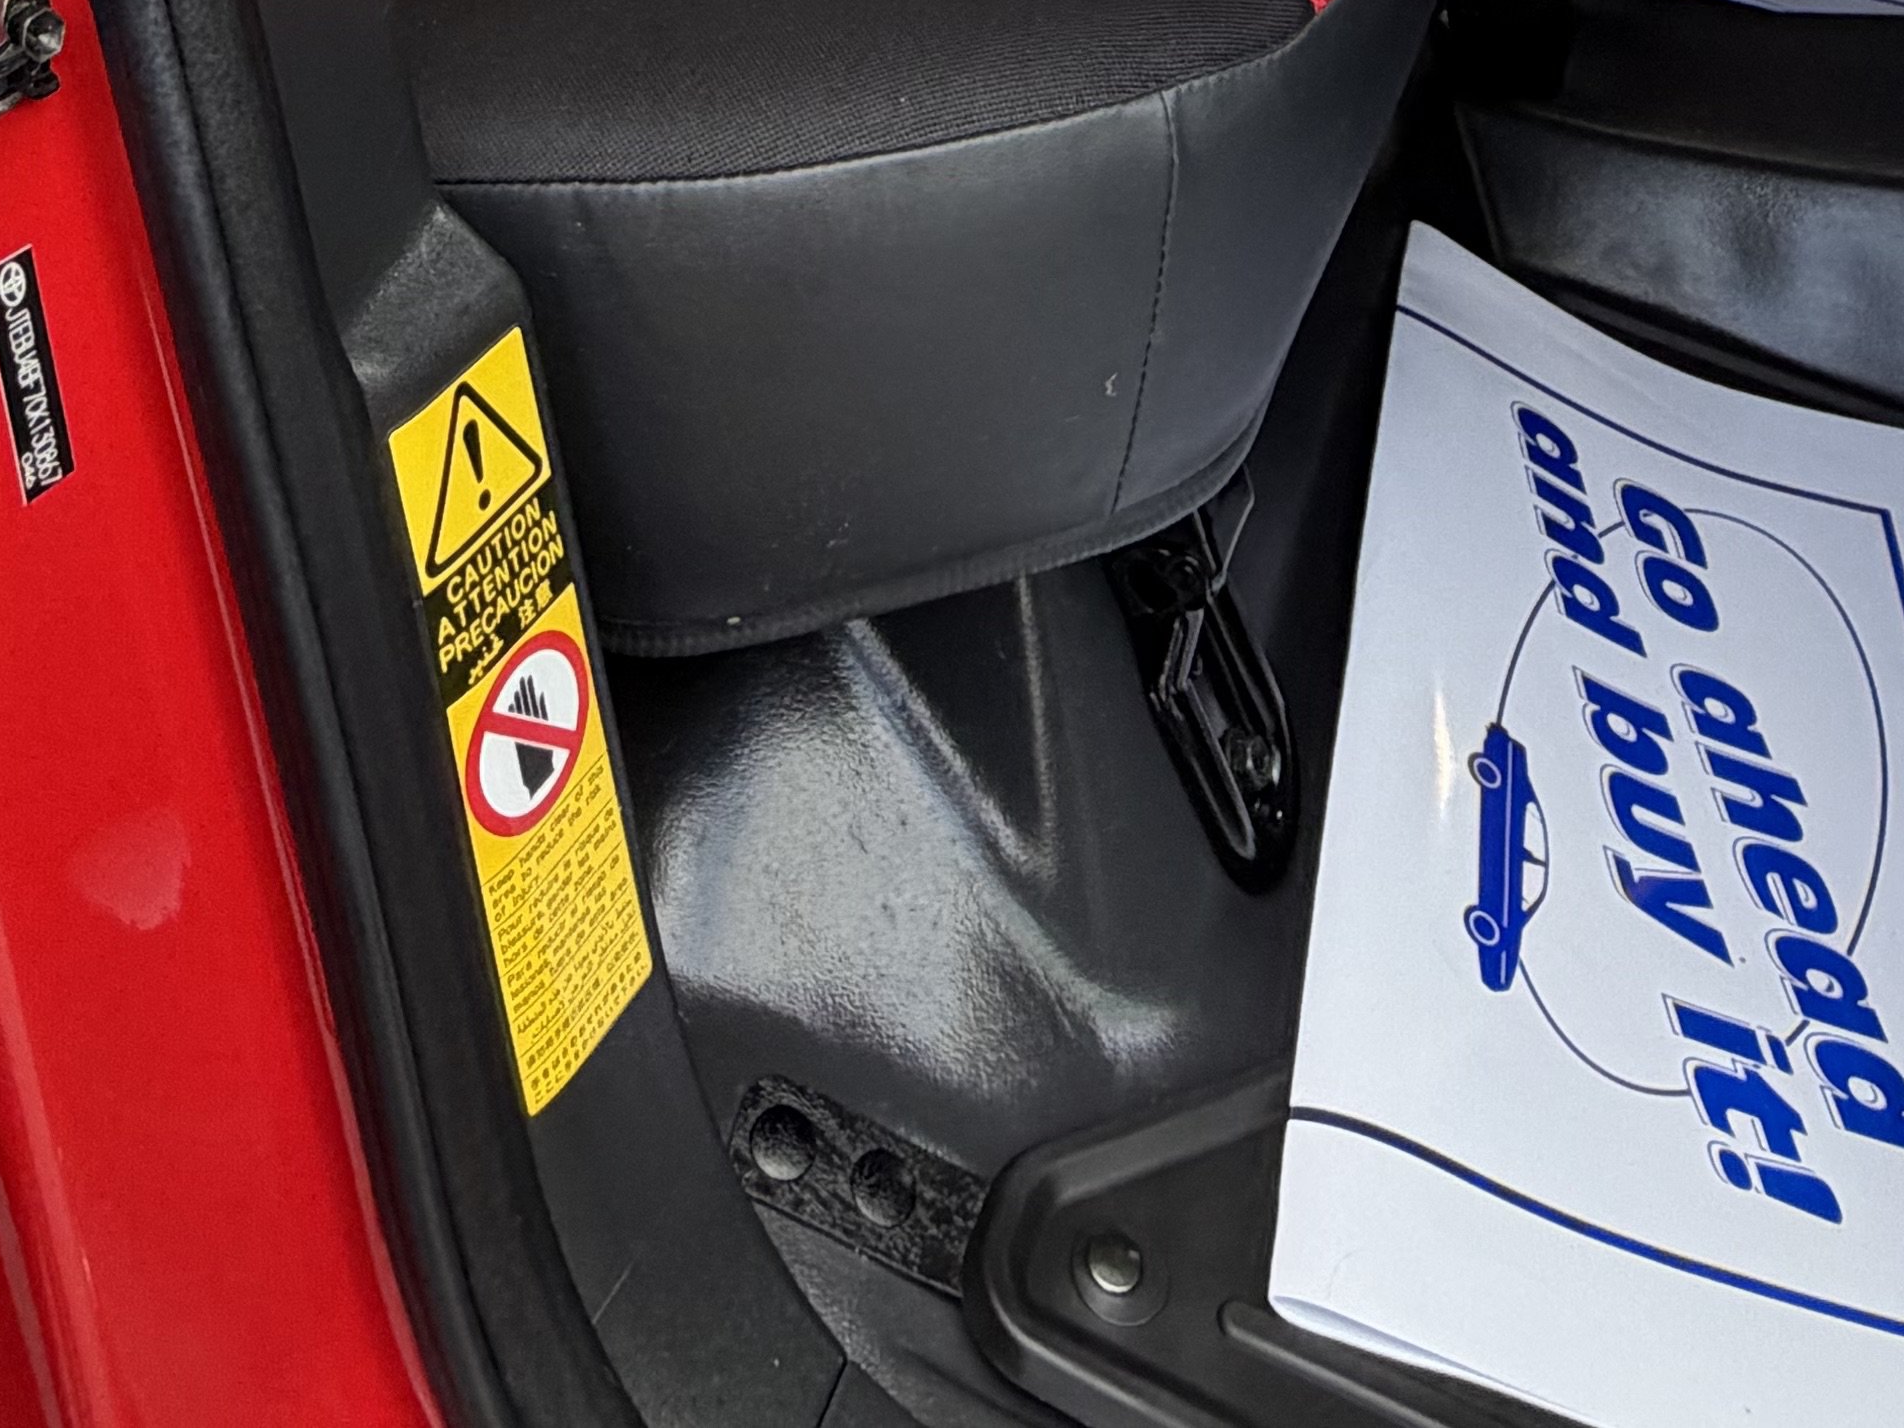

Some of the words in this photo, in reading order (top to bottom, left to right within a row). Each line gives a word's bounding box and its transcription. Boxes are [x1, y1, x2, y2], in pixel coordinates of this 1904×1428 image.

[438, 510, 557, 645] ATTENTION
[446, 497, 540, 604] CAUTION
[1509, 400, 1646, 655] and
[1610, 478, 1721, 634] Go
[438, 534, 564, 674] PRECAUCION
[518, 579, 553, 630] 注意
[1573, 665, 1734, 966] buy
[1661, 992, 1844, 1226] it!
